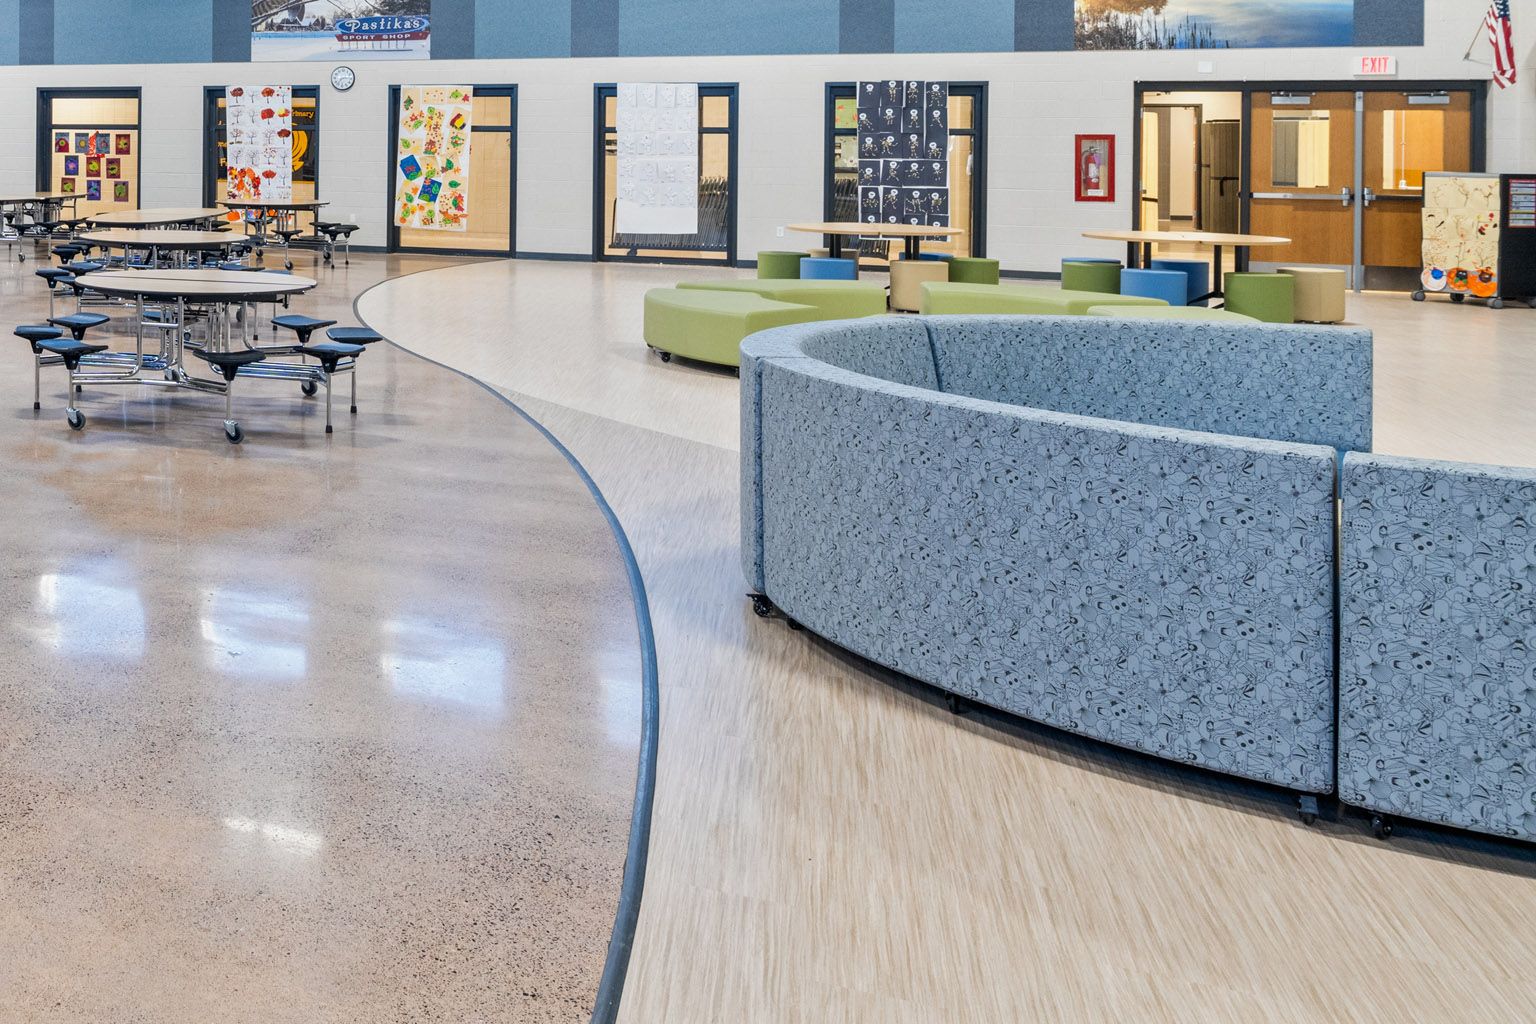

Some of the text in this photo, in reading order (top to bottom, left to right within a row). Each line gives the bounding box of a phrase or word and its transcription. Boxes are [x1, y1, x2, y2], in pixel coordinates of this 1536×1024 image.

[344, 18, 420, 32] Pastika's
[1362, 57, 1390, 72] EXIT
[292, 108, 314, 118] rimary
